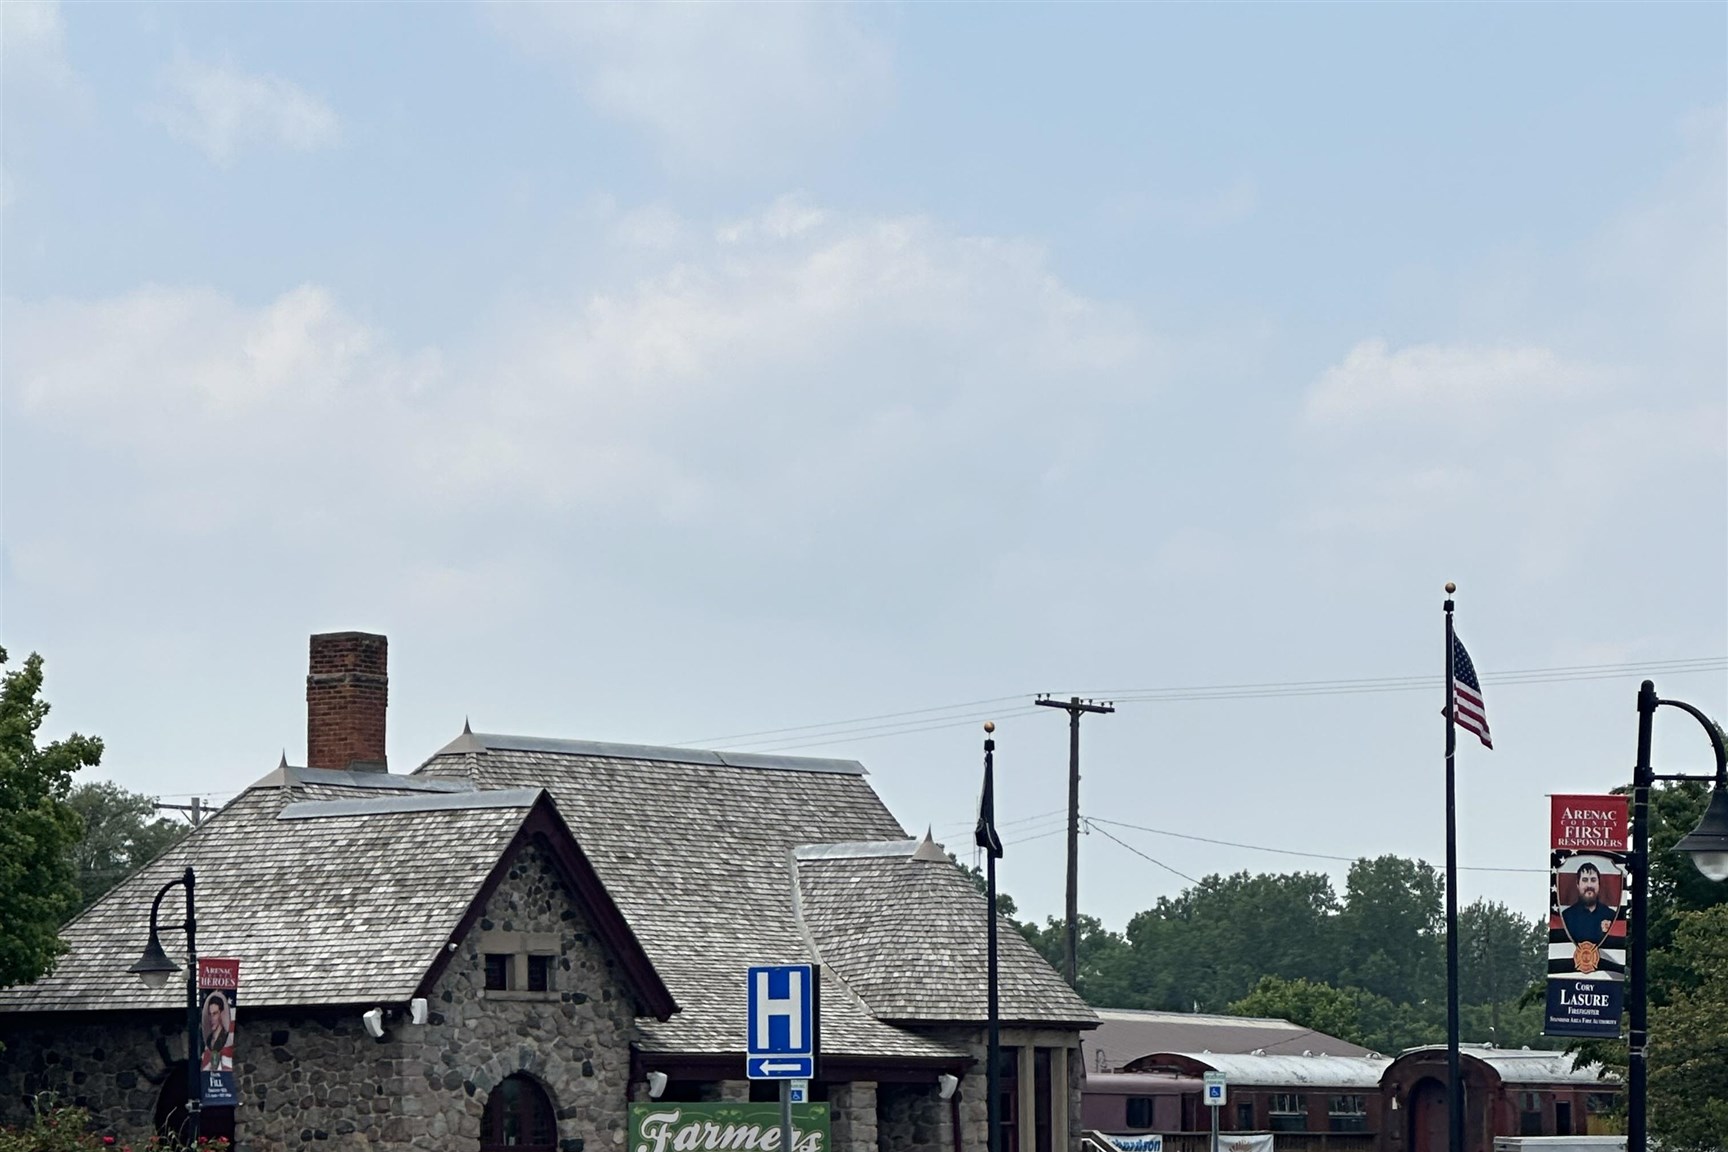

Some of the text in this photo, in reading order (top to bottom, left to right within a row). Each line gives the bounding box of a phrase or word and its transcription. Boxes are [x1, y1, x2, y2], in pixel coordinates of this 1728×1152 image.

[1562, 806, 1617, 821] ARENAC
[1565, 826, 1613, 839] FIRST
[1558, 838, 1623, 848] RESPONDERS
[201, 976, 236, 987] HEROES
[1575, 981, 1595, 992] CORY
[1560, 988, 1610, 1007] LASURE
[756, 971, 802, 1050] H
